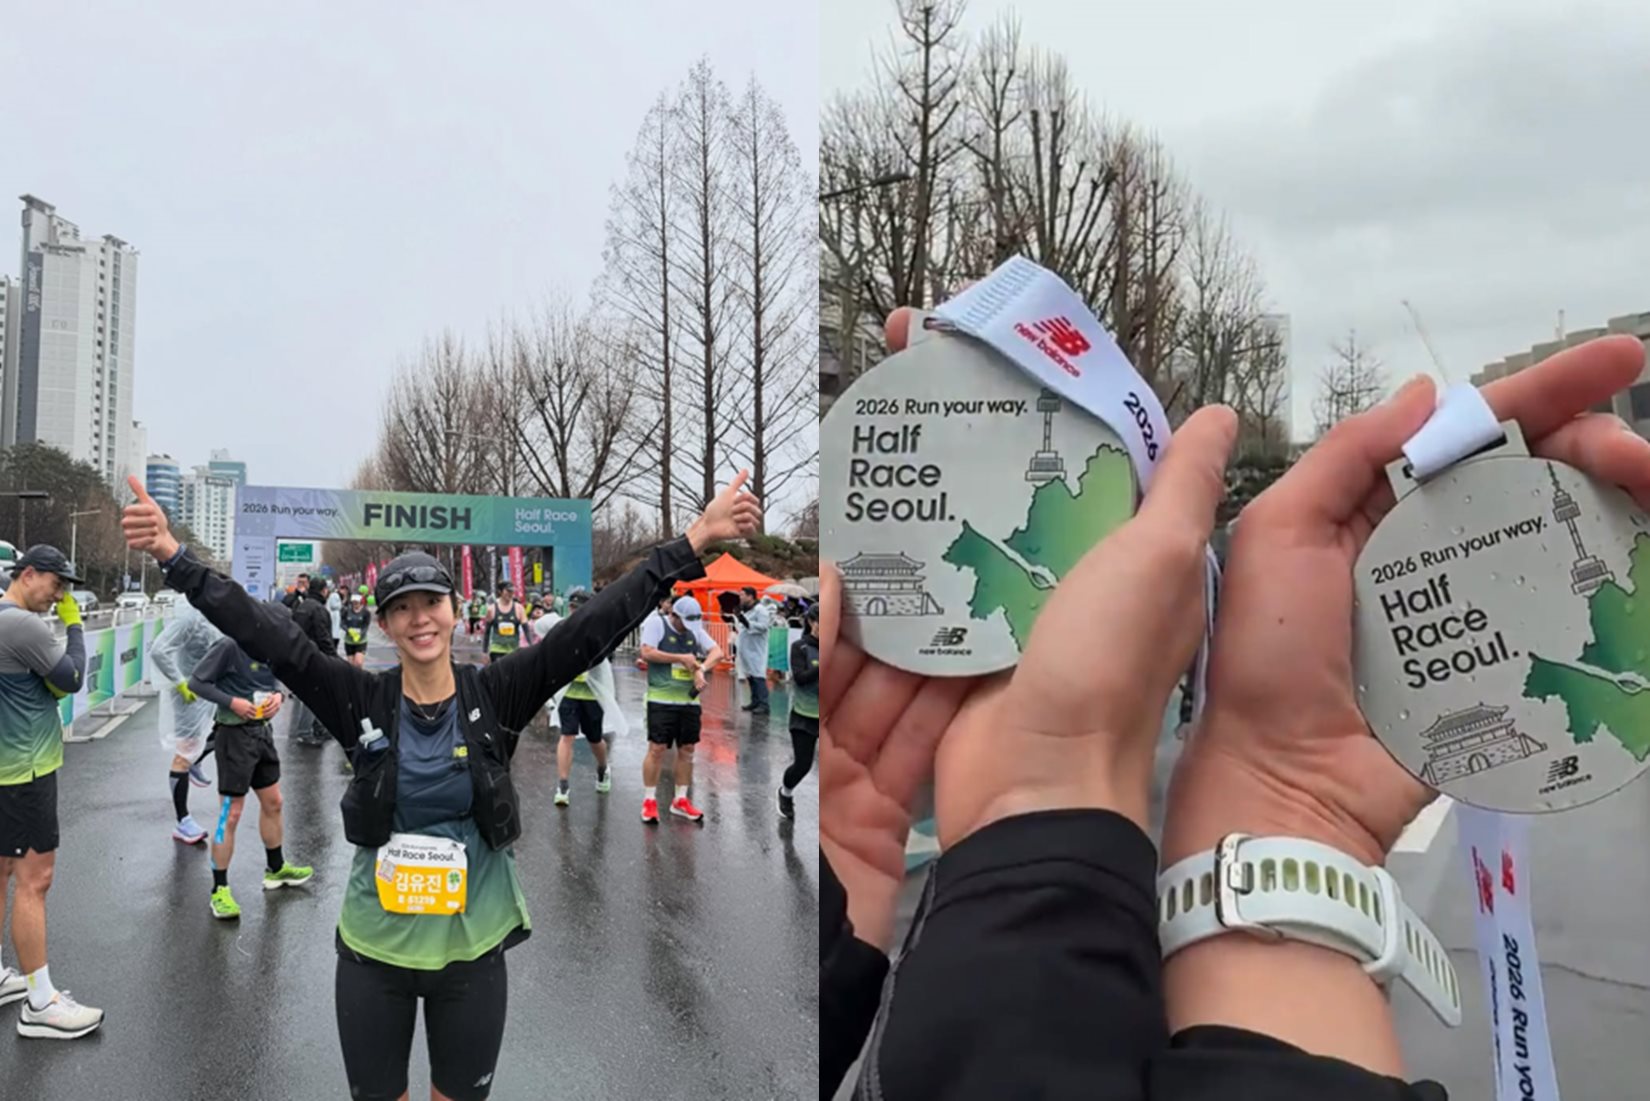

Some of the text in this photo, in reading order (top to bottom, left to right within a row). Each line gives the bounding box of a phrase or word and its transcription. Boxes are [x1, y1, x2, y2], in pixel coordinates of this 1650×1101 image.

[1037, 338, 1081, 378] balance
[856, 399, 1028, 417] 2026 Run your way.
[852, 424, 922, 453] Half
[1123, 391, 1159, 462] 2026
[849, 458, 942, 488] Race
[243, 503, 268, 513] 2026
[271, 504, 291, 514] Run
[292, 506, 315, 516] your
[363, 503, 472, 531] FINISH
[515, 508, 577, 521] Half Race
[845, 492, 955, 522] Seoul.
[515, 520, 555, 533] Seoul.
[1370, 515, 1548, 584] 2026 Run your way.
[1379, 574, 1453, 622] Half
[1391, 606, 1488, 656] Race
[1403, 631, 1519, 689] Seoul.
[402, 849, 426, 860] Race
[396, 872, 441, 893] 김유진
[1503, 933, 1527, 1002] 2026
[1511, 1006, 1529, 1060] Run
